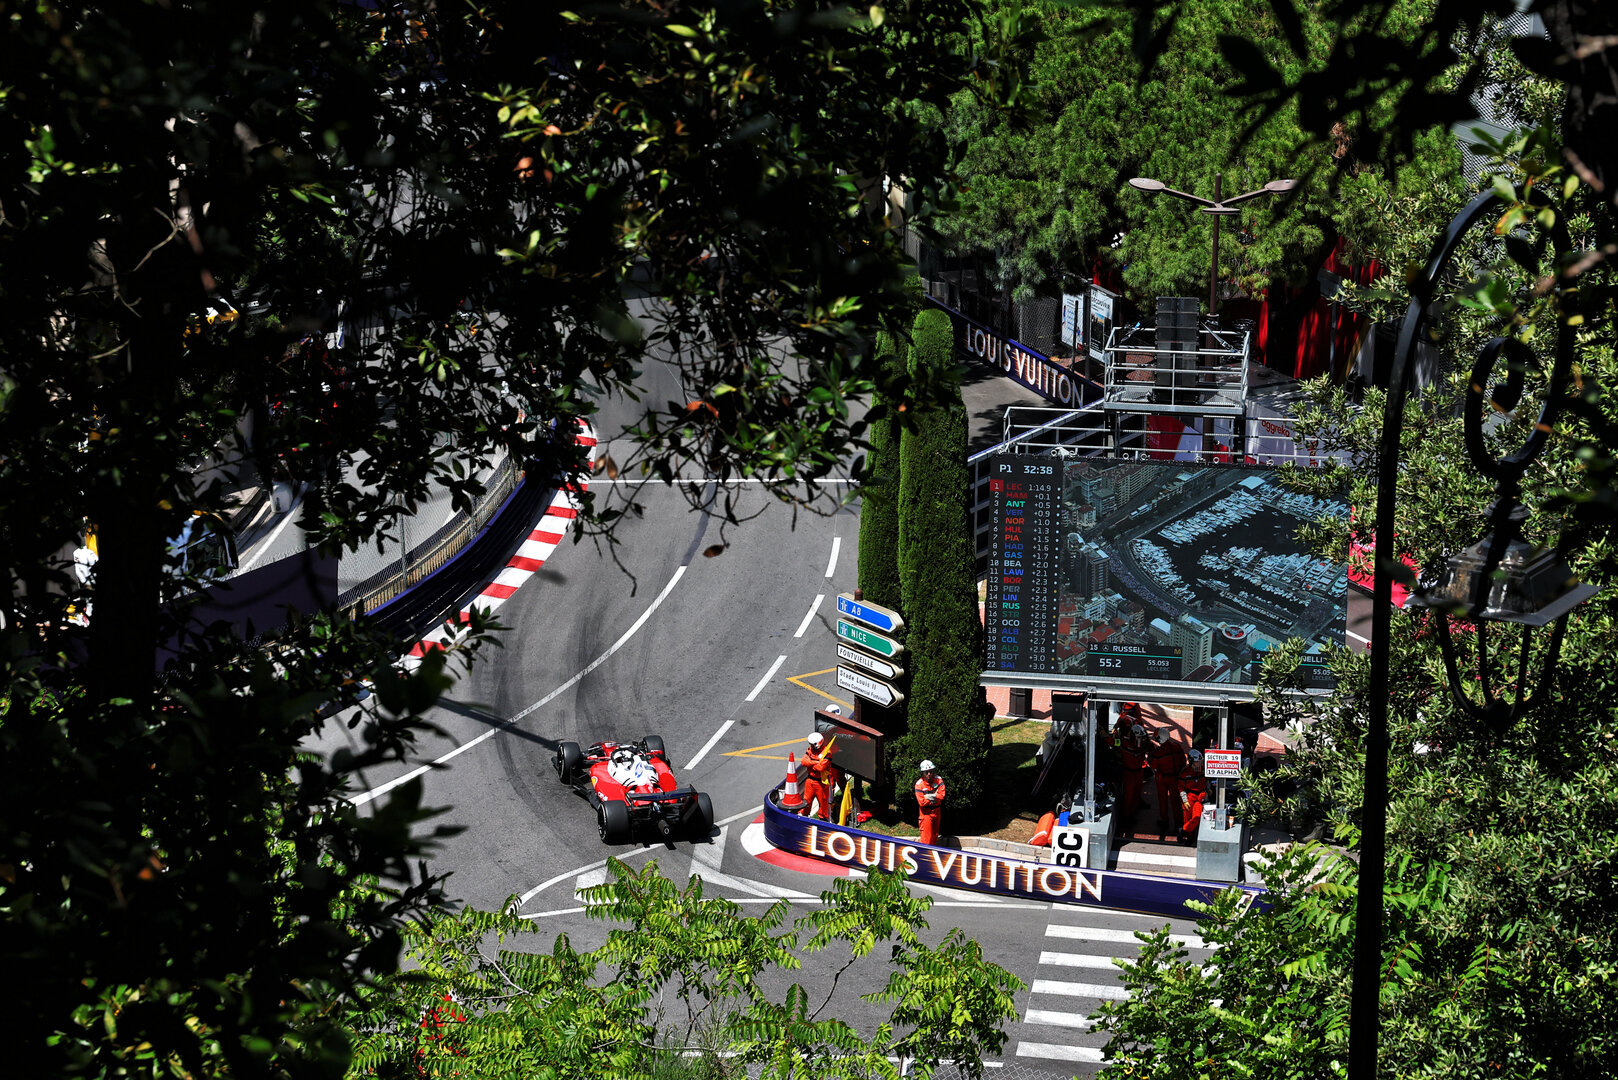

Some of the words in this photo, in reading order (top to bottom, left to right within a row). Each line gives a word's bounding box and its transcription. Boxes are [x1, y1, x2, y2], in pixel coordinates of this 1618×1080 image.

[967, 322, 1012, 372] LOUIS
[1015, 348, 1084, 409] VUITTON
[1261, 420, 1290, 438] aggreko
[1000, 464, 1012, 473] P1
[1024, 465, 1053, 475] 32:38
[851, 604, 862, 616] A8
[851, 628, 867, 643] NICE
[840, 648, 874, 668] FONTVIEILLE
[1112, 645, 1146, 654] RUSSELL
[1099, 658, 1122, 668] 55.2
[840, 670, 854, 681] Stade
[856, 677, 870, 687] Louis
[1056, 832, 1082, 867] SC
[810, 826, 918, 876] LOUIS
[931, 850, 1103, 902] VUITTON
